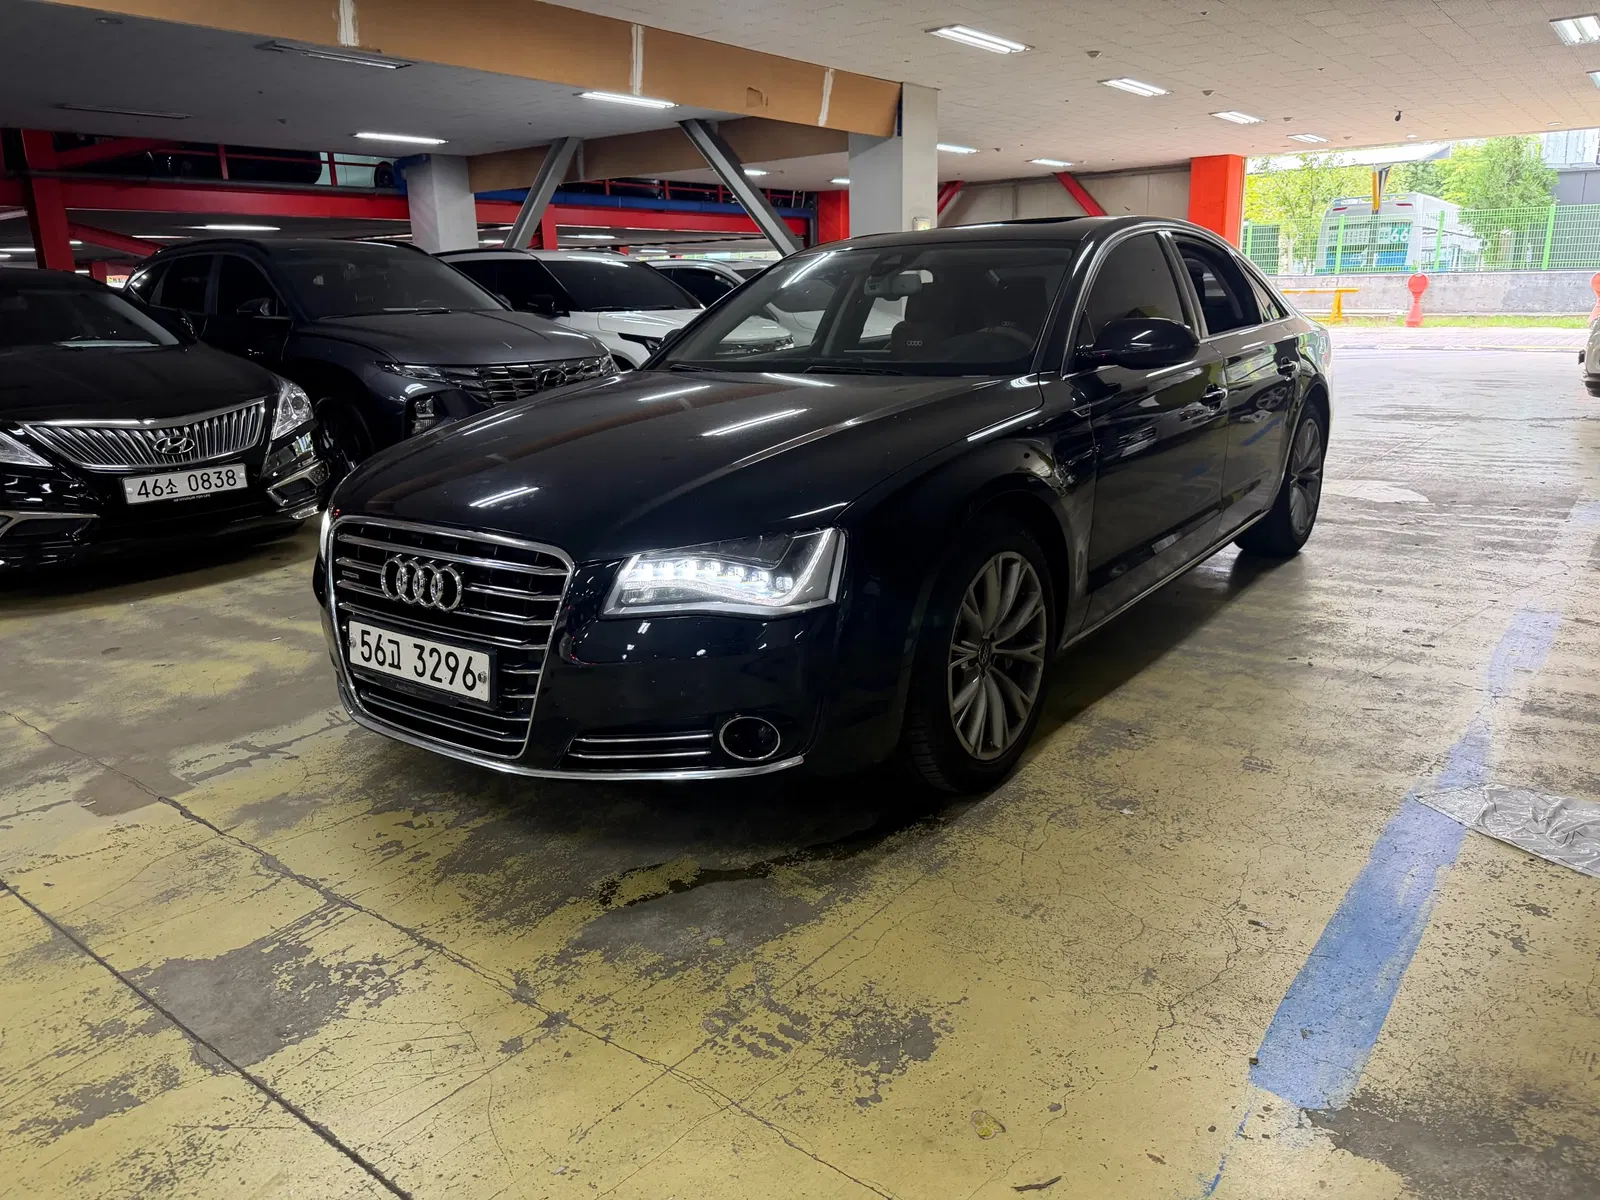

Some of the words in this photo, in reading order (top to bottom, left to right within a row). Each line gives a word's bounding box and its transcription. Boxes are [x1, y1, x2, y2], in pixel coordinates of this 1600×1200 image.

[137, 478, 179, 498] 46소
[187, 469, 237, 492] 0838
[360, 630, 402, 670] 56고
[413, 643, 477, 692] 3296
